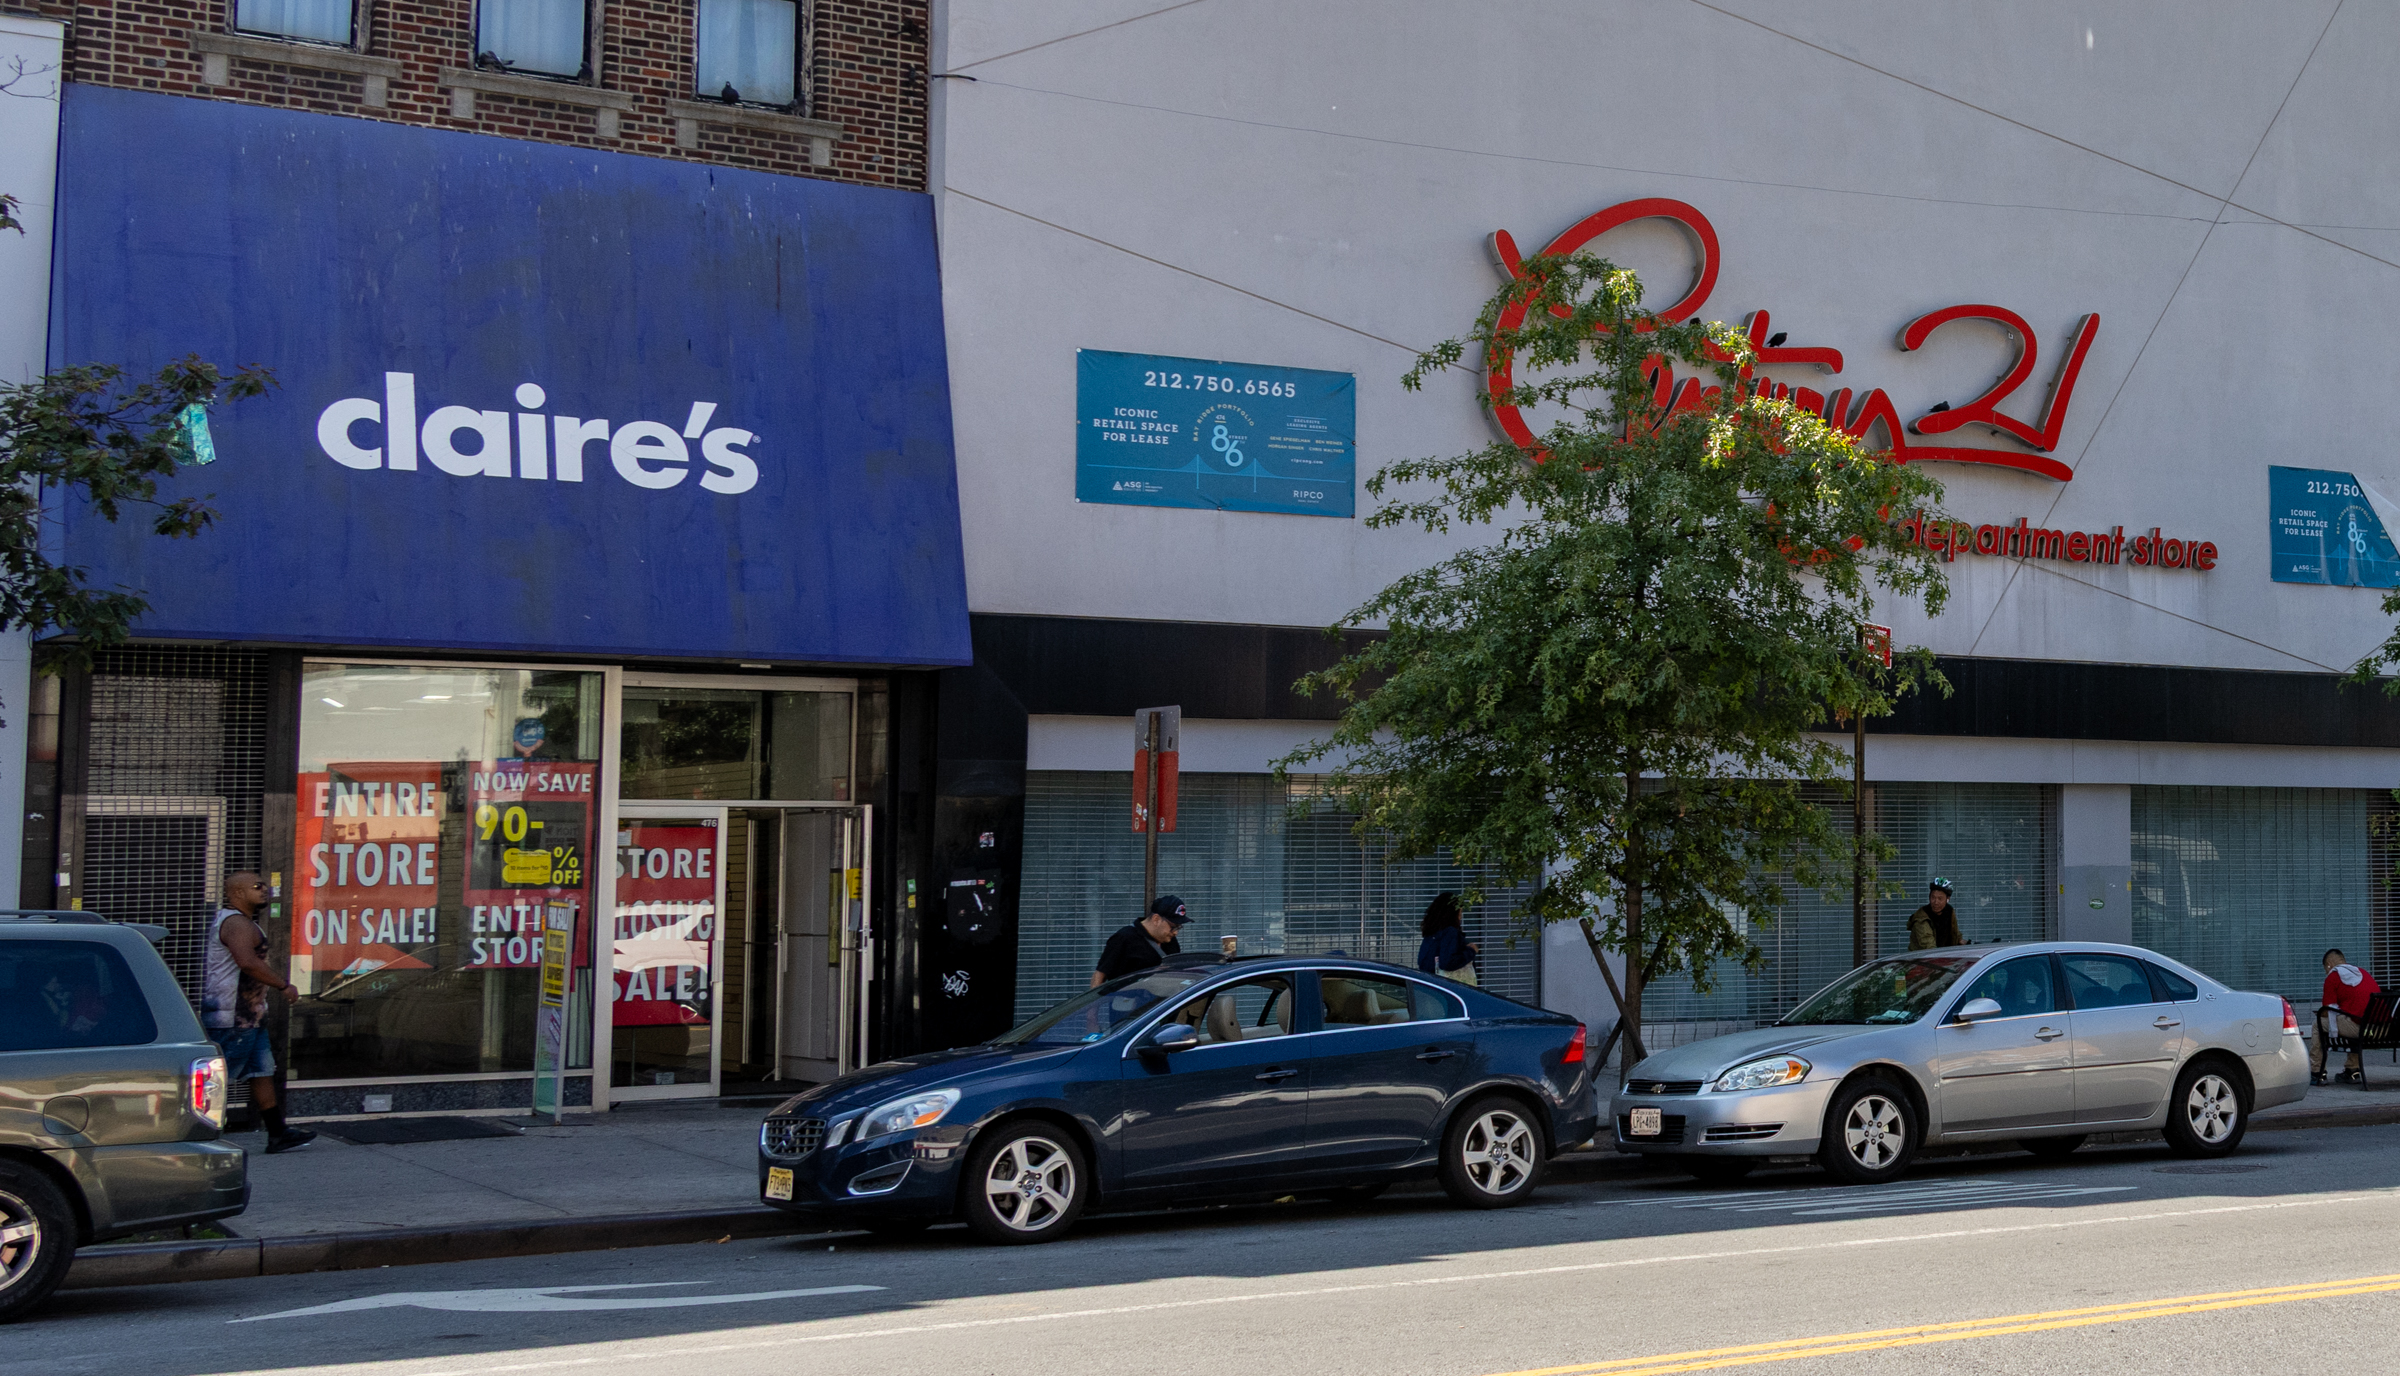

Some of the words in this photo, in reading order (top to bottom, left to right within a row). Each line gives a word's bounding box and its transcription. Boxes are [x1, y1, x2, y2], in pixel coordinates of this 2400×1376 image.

[1144, 371, 1296, 398] 212.750.6565
[1896, 304, 2101, 452] 21
[1114, 407, 1159, 419] ICONIC
[1216, 403, 1256, 427] PORTFOLIO
[317, 371, 758, 494] claire's
[1093, 418, 1137, 430] RETAIL
[1140, 422, 1179, 433] SPACE
[1102, 432, 1127, 442] FOR
[1131, 434, 1169, 445] LEASE
[1211, 424, 1244, 467] 86
[1293, 490, 1324, 500] RIPCO
[2278, 518, 2304, 526] RETAIL
[2306, 520, 2328, 528] SPACE
[2290, 509, 2317, 518] ICONIC
[1898, 508, 2125, 564] department
[2130, 527, 2219, 571] store
[2284, 528, 2299, 536] FOR
[2301, 529, 2324, 538] LEASE
[473, 772, 530, 792] NOW
[538, 772, 591, 793] SAVE
[314, 782, 436, 818] ENTIRE
[701, 819, 718, 828] 476
[310, 842, 436, 887] STORE
[552, 870, 581, 885] OFF
[304, 908, 348, 946] ON
[360, 907, 436, 945] SALE!
[617, 899, 714, 941] LOSING
[472, 936, 544, 965] STOR
